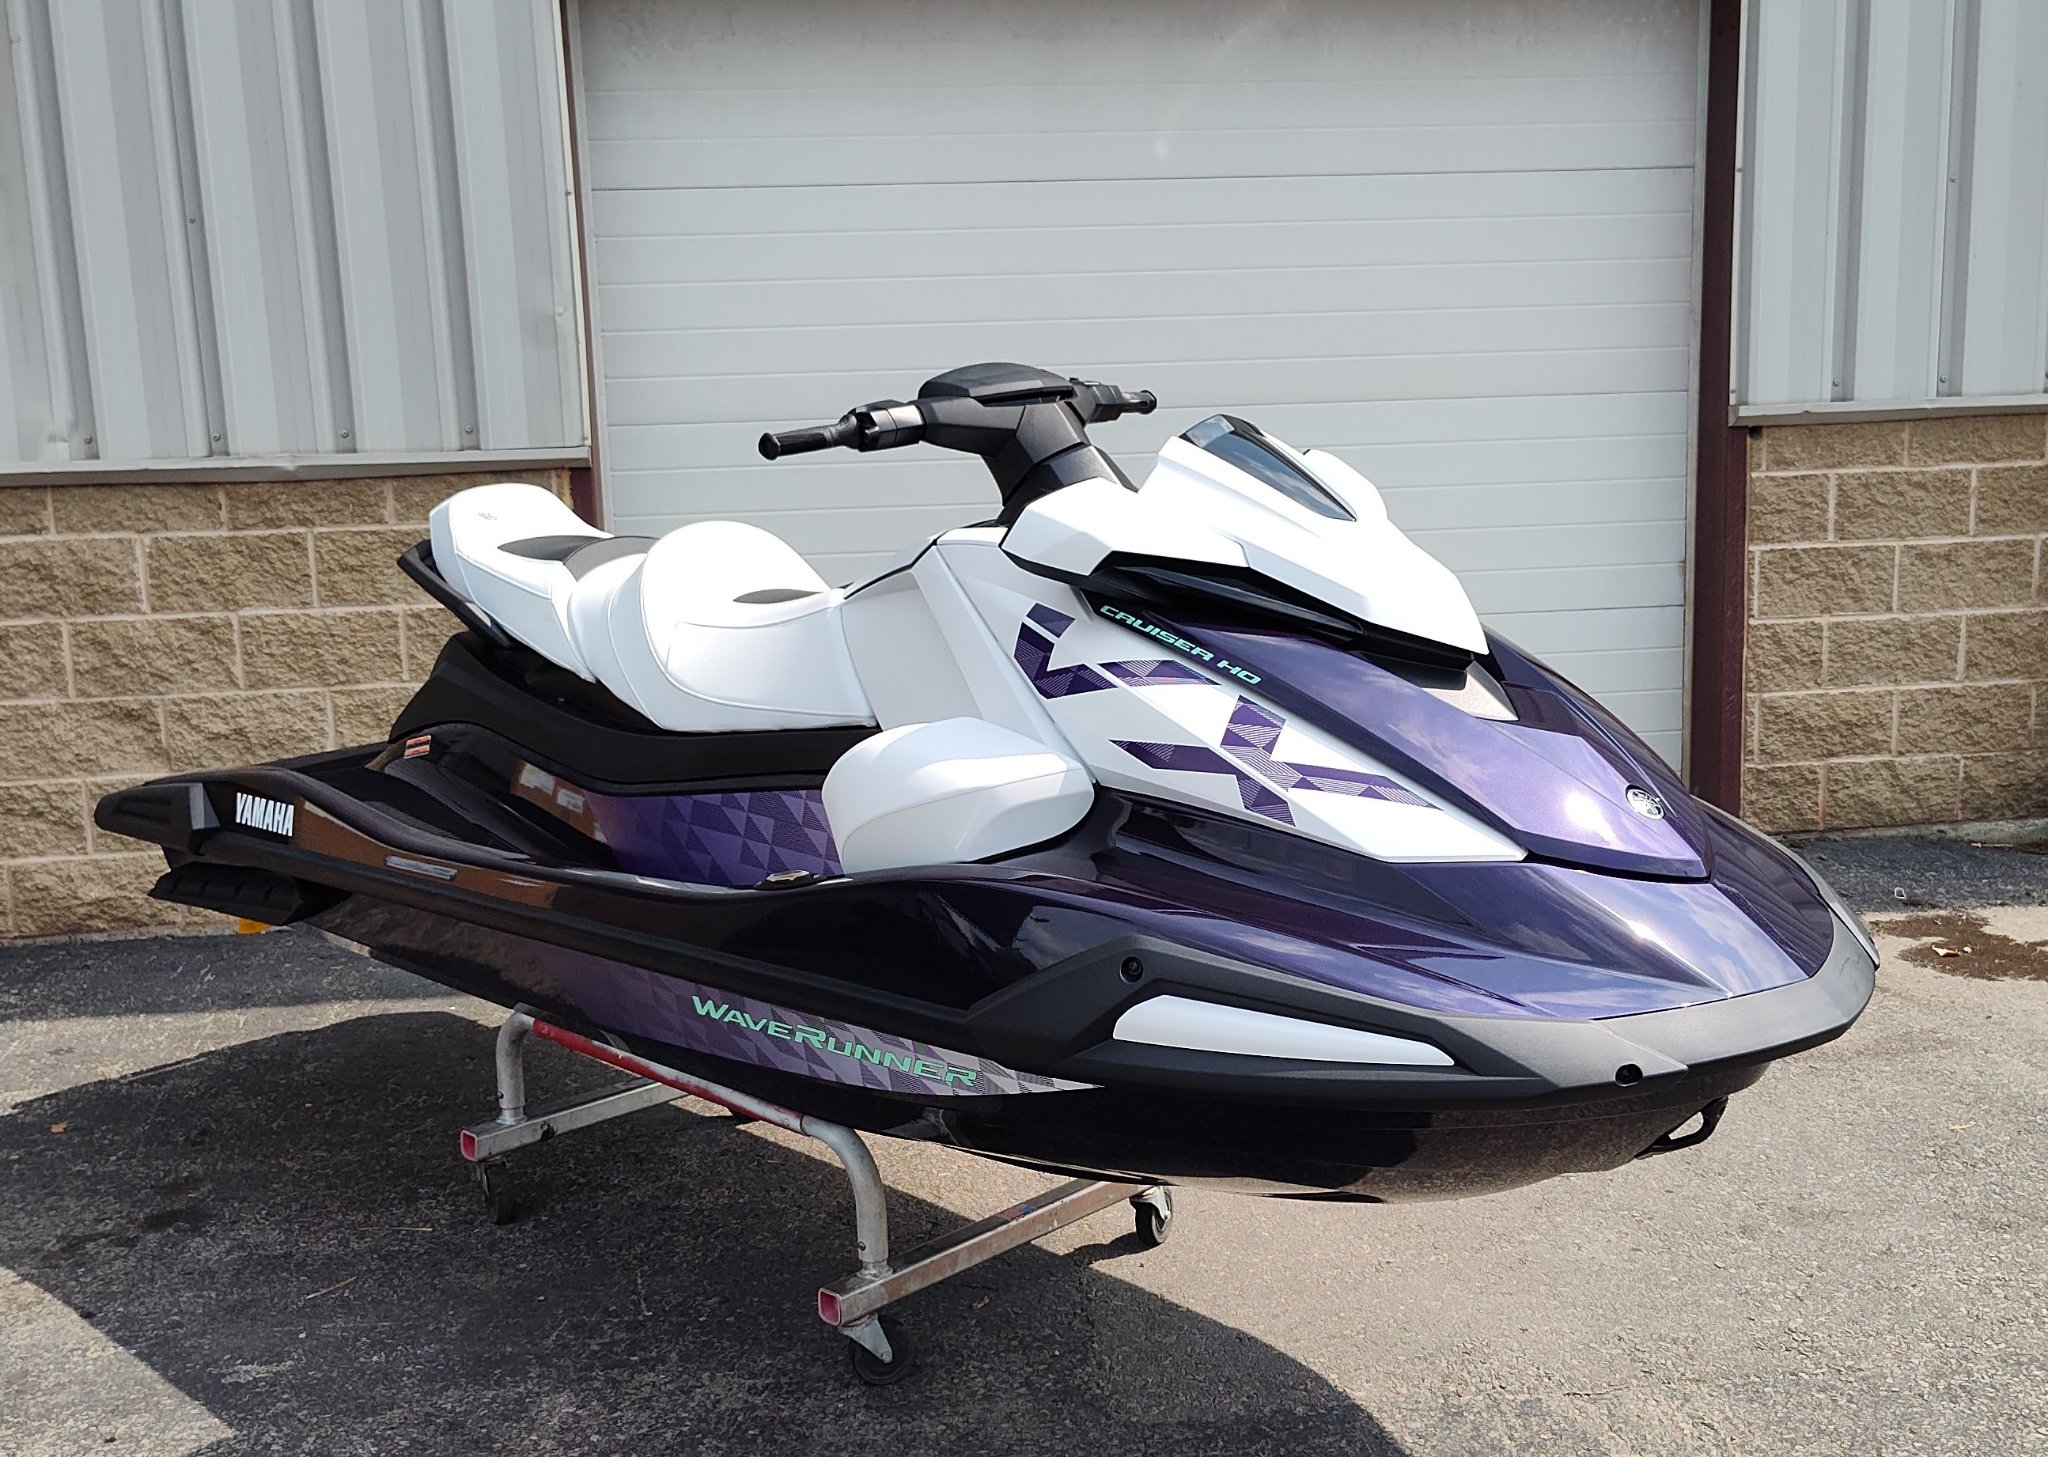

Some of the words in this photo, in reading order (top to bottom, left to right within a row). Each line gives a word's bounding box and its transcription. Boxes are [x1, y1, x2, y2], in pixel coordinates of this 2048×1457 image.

[1100, 605, 1214, 661] CRUISER
[1217, 660, 1262, 685] HO
[235, 792, 295, 837] YAMAHA
[691, 995, 977, 1087] WAVERUNNER
